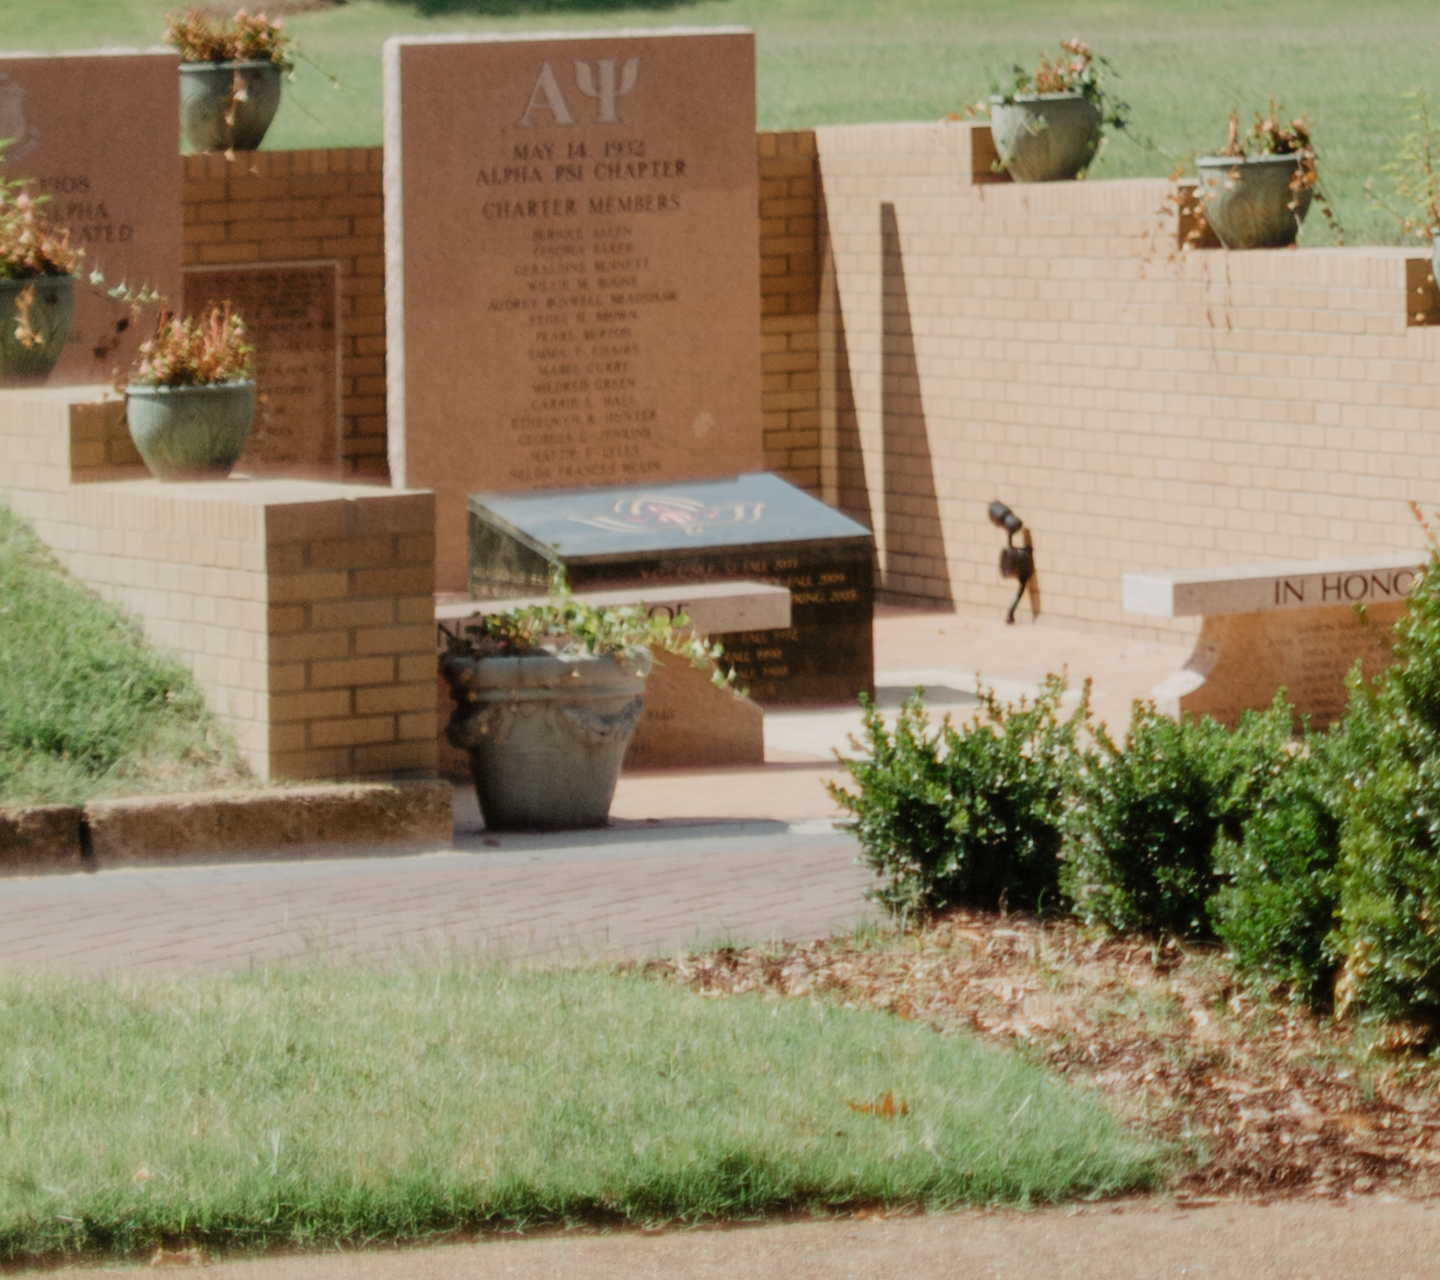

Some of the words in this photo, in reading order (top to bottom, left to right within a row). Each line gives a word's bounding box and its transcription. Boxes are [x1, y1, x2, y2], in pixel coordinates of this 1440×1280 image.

[512, 142, 553, 161] MAY
[604, 139, 647, 158] 1932
[476, 164, 543, 186] ALPHA
[555, 162, 585, 184] PSI
[593, 157, 687, 181] CHAPTER
[481, 197, 577, 221] CHARTER
[588, 192, 681, 216] MEMBERS
[1275, 578, 1305, 606] IN
[1321, 567, 1415, 602] HONO
